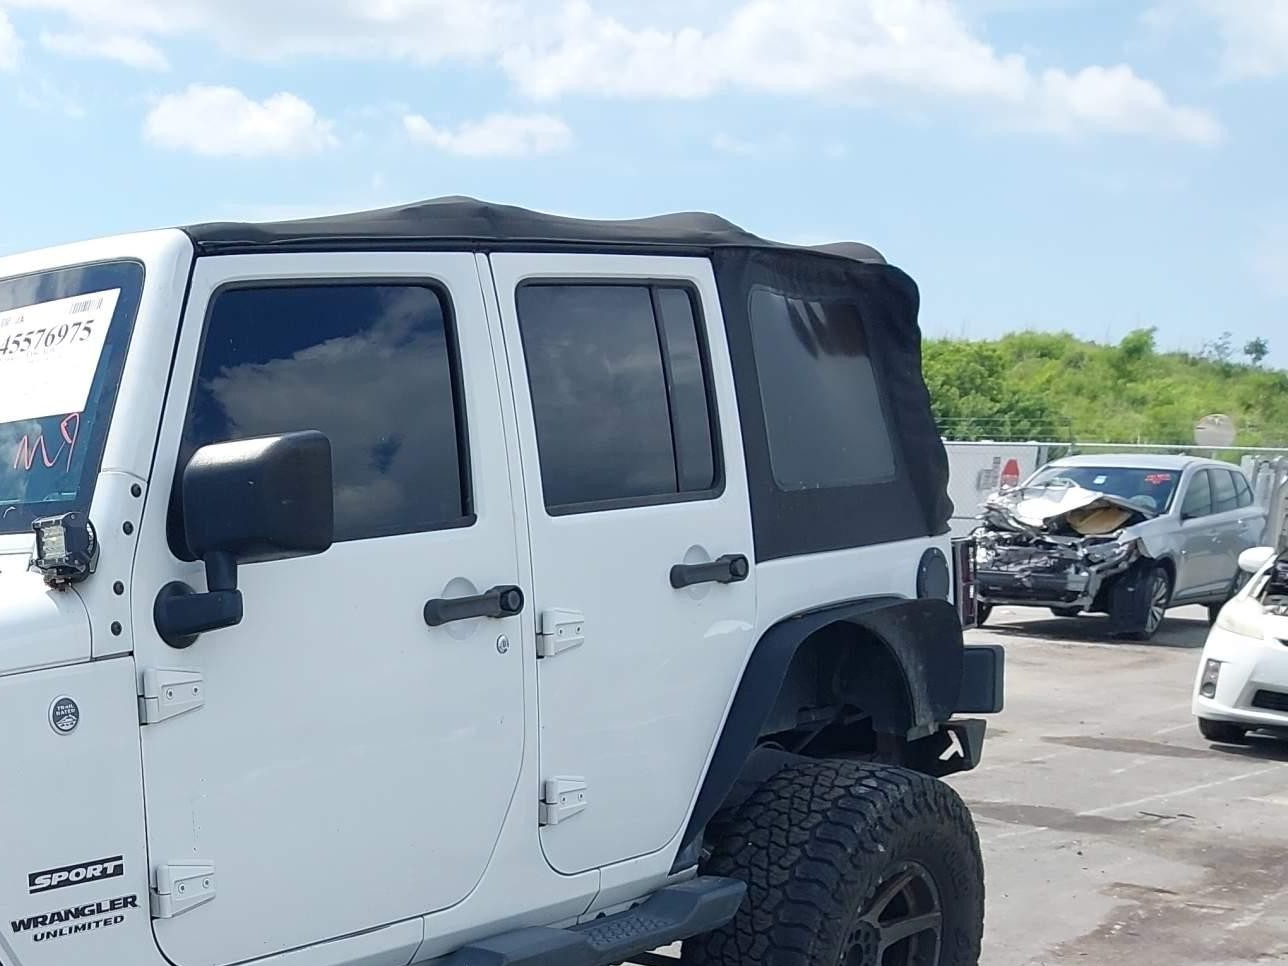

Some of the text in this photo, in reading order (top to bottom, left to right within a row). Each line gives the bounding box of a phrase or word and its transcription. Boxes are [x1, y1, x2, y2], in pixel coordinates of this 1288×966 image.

[32, 860, 123, 888] SPORT
[11, 894, 138, 933] WRANGLER
[33, 915, 125, 942] UNLIMITED
